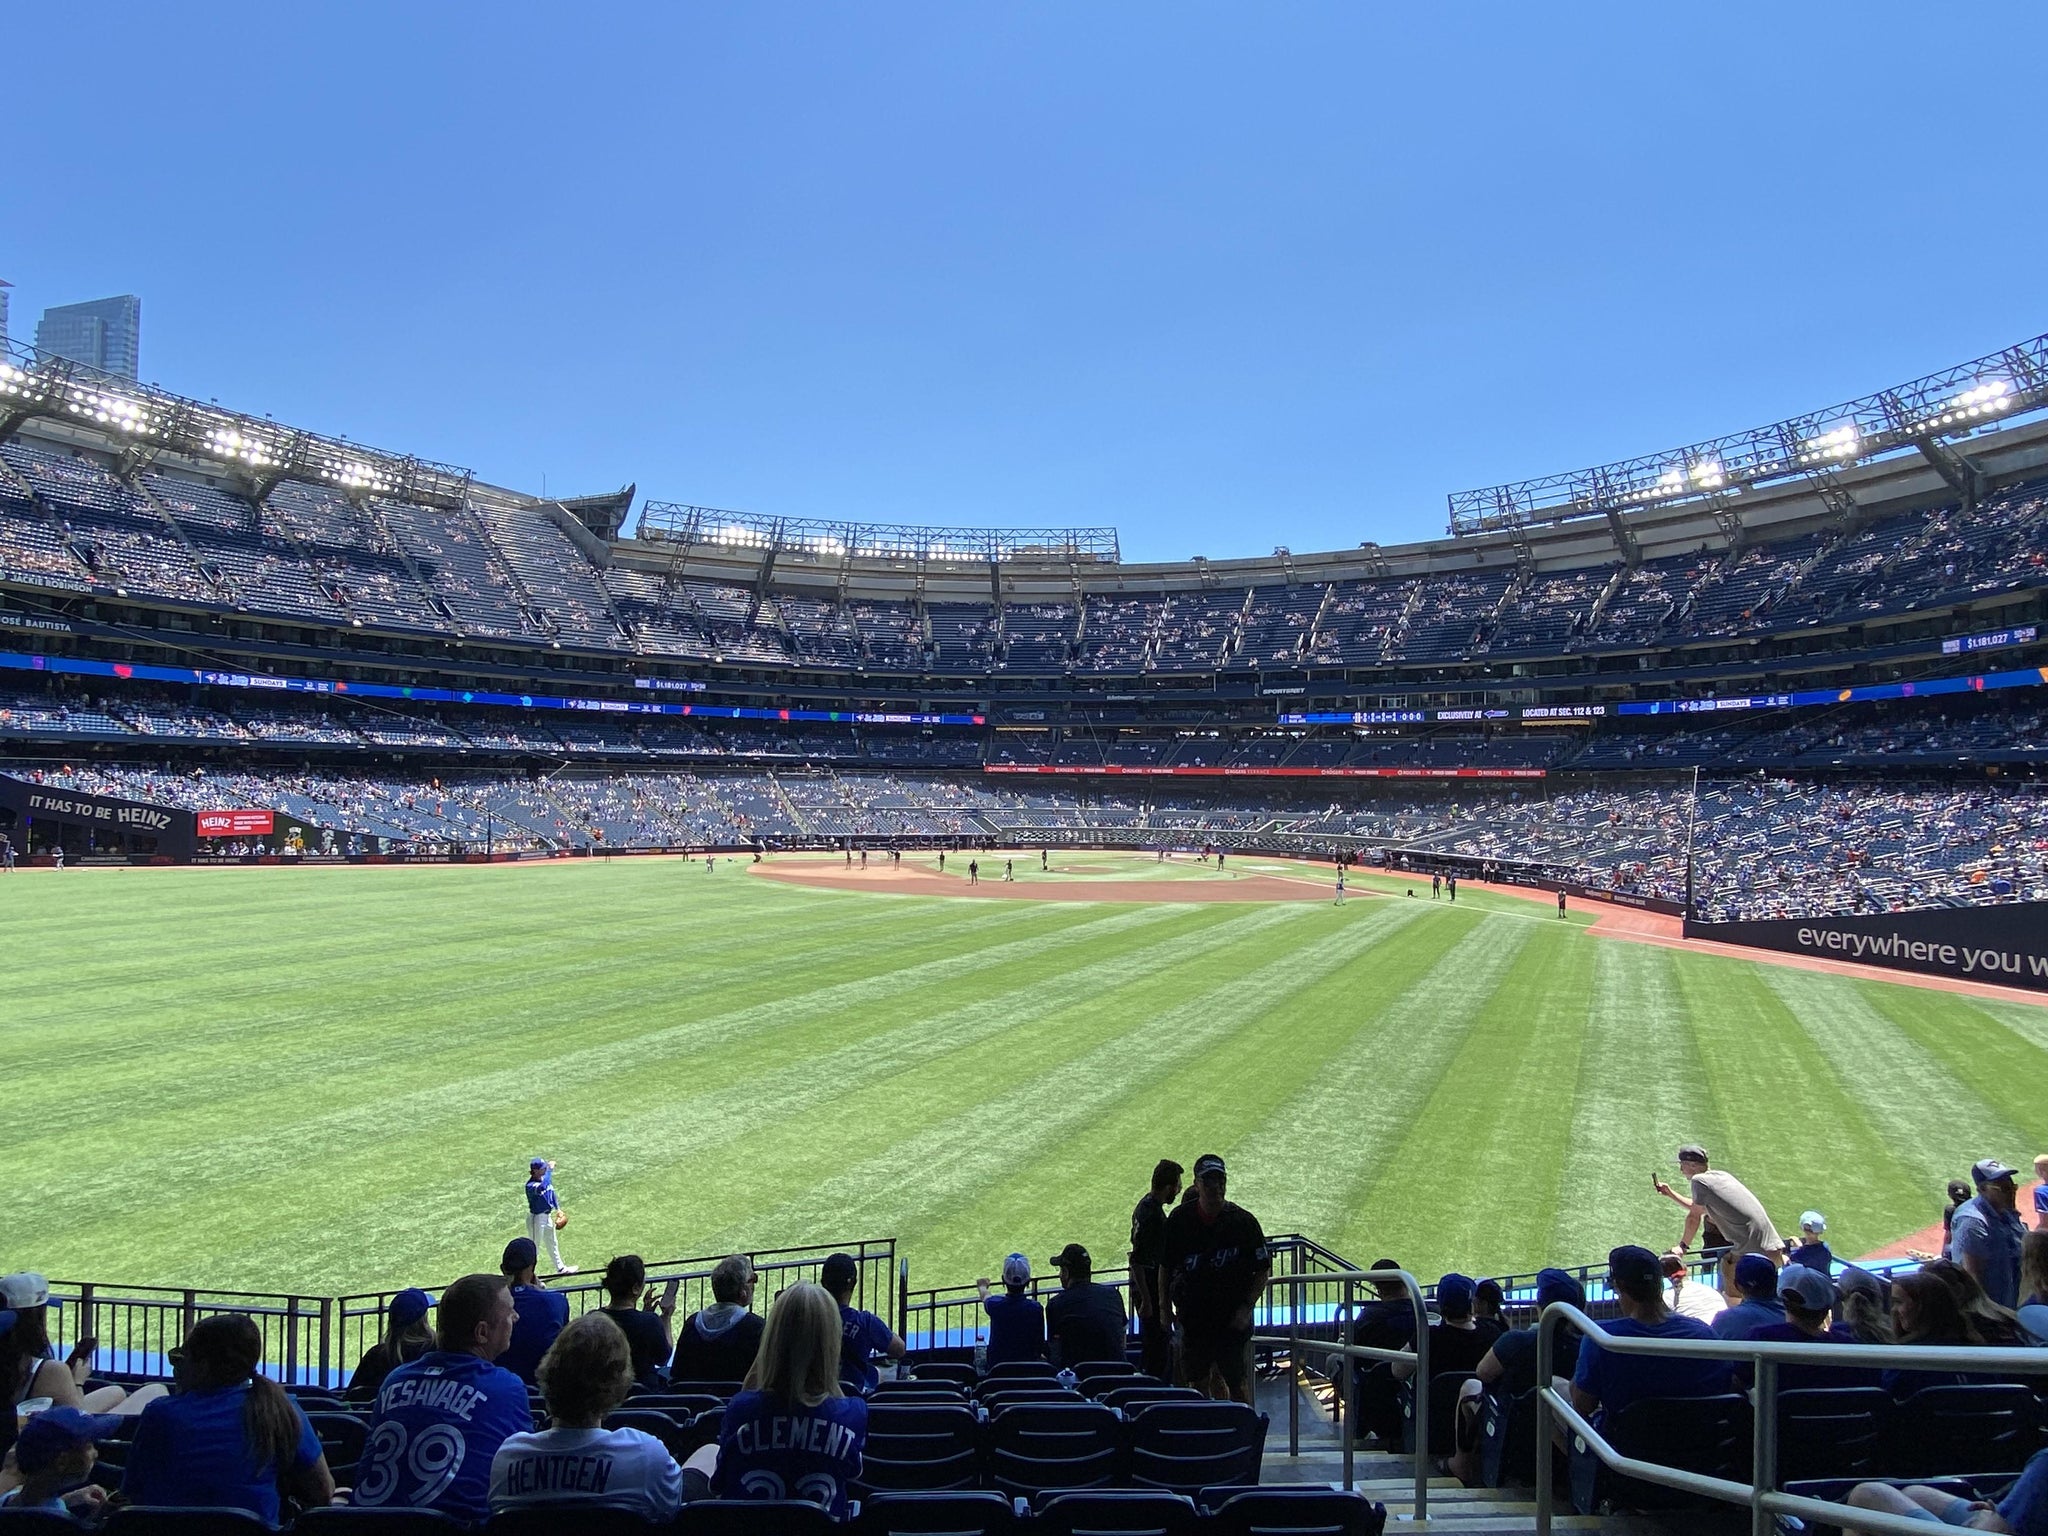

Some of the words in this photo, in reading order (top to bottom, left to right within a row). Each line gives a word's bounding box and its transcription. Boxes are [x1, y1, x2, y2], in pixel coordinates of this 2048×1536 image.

[10, 574, 43, 586] JACKIE
[45, 580, 93, 593] ROBINSON
[0, 617, 21, 626] OSÉ
[26, 619, 72, 632] BAUTISTA
[1437, 710, 1474, 720] EXCLUSIVELY
[1474, 710, 1482, 719] AT
[1522, 707, 1549, 717] LOCATED
[1550, 707, 1558, 716] AT
[1558, 707, 1572, 716] SEC.
[1573, 706, 1585, 716] 112
[1585, 706, 1592, 715] &
[1593, 706, 1605, 715] 123
[29, 795, 43, 807] IT
[45, 798, 73, 812] HAS
[75, 802, 93, 816] TO
[95, 806, 112, 819] BE
[118, 808, 172, 829] HEINZ
[201, 816, 232, 829] HEINZ
[1797, 927, 1957, 965] everywhere
[1962, 946, 2021, 973] you
[380, 1380, 488, 1421] YESAVAGE
[737, 1416, 856, 1460] CLEMENT
[354, 1420, 466, 1508] 39
[508, 1454, 614, 1496] HENTGEN
